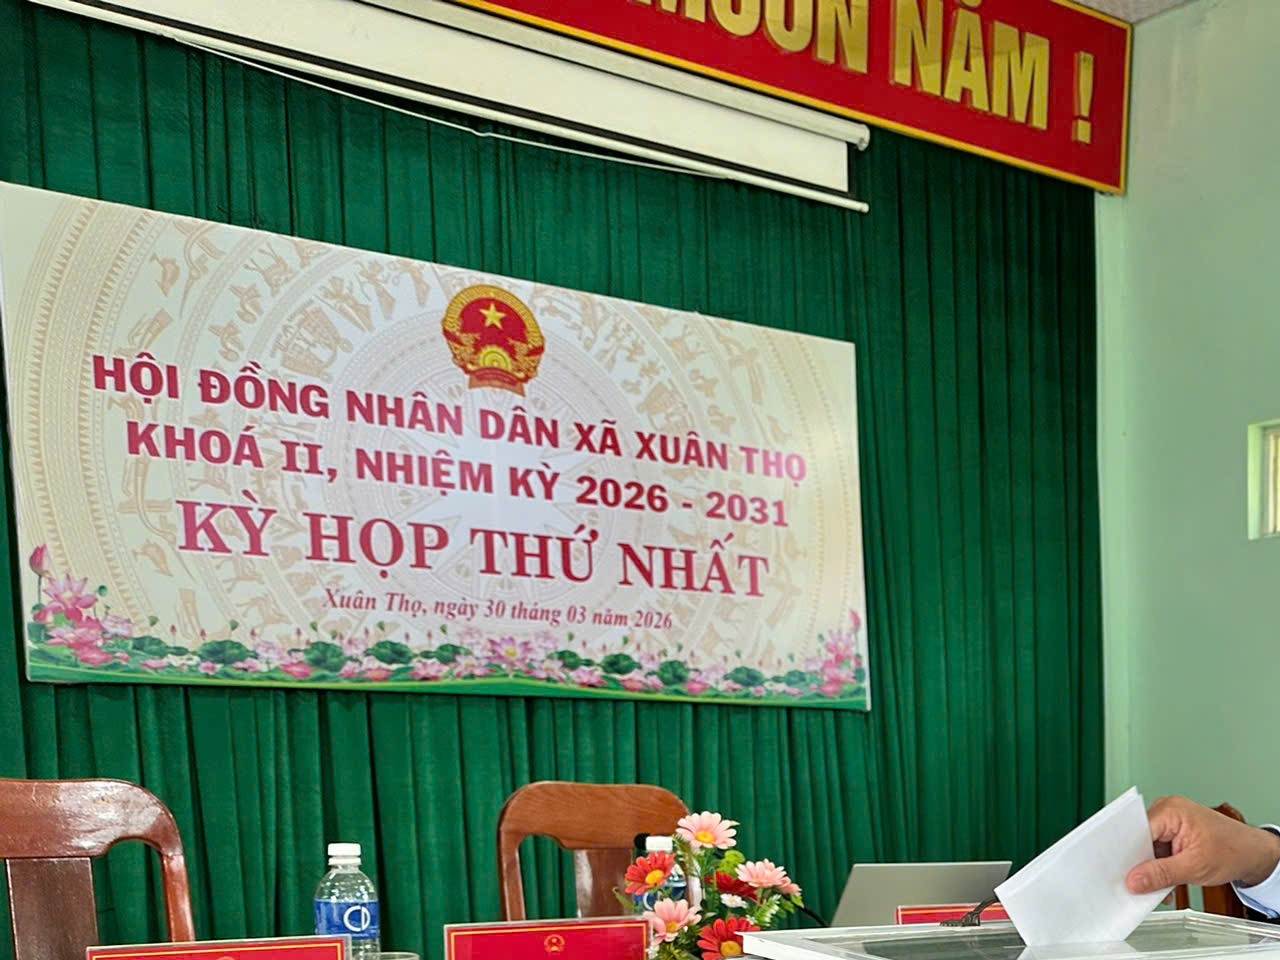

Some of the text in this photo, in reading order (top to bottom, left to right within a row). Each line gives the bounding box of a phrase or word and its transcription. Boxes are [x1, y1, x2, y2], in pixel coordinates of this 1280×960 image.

[893, 0, 1050, 131] NĂM
[1075, 50, 1095, 144] !
[92, 352, 807, 488] HỘI ĐỒNG NHÂN DÂN XÃ XUÂN THỌ
[126, 420, 263, 469] KHOÁ
[280, 440, 338, 484] II,
[355, 449, 494, 496] NHIỆM
[508, 462, 561, 501] KỲ
[575, 475, 669, 513] 2026
[705, 491, 789, 528] 2031
[175, 489, 770, 598] KỲ HỌP THỨ NHẤT
[321, 587, 673, 631] Xuân Thọ, ngày 30 tháng 03 năm 2026
